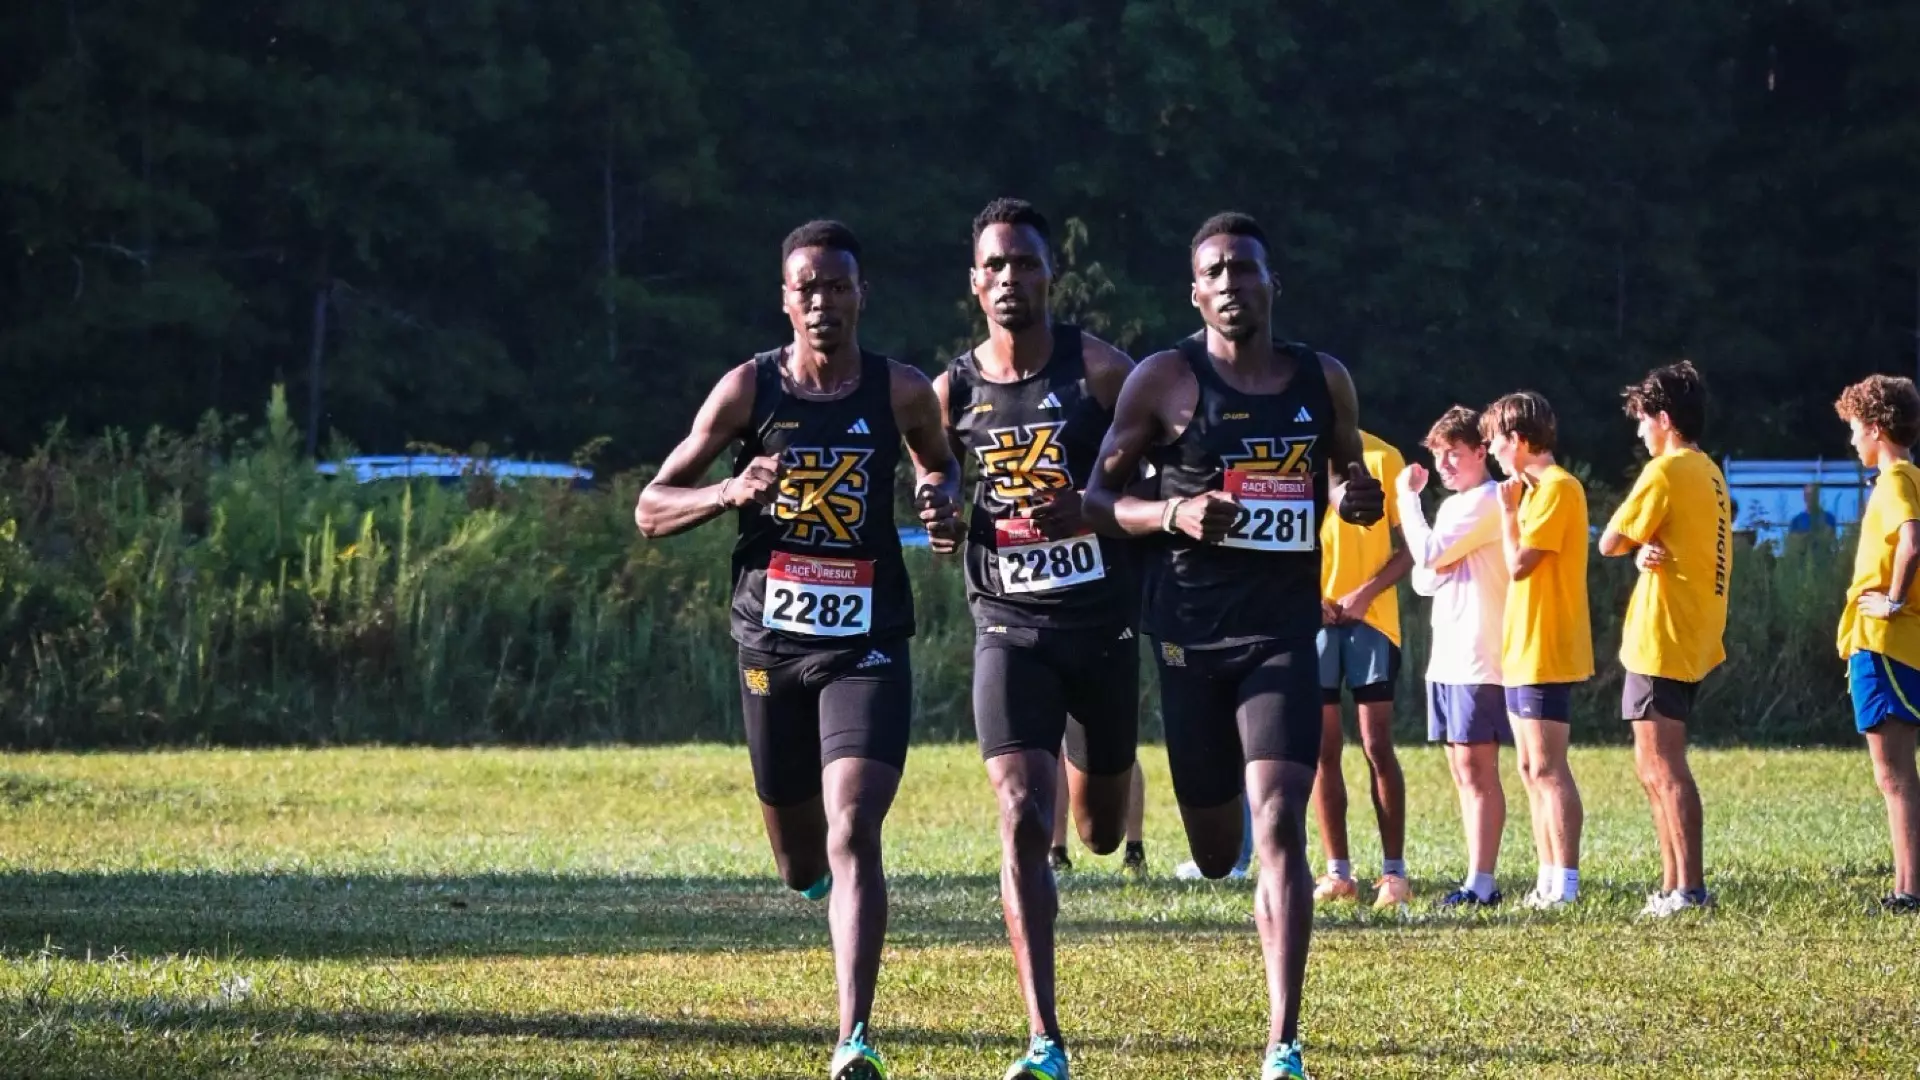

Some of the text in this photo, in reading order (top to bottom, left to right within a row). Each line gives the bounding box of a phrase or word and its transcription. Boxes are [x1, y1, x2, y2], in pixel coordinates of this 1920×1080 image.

[1241, 482, 1306, 493] RACE RESULT
[1227, 507, 1308, 543] 2281
[1711, 477, 1727, 595] FLY HIGHER
[784, 564, 811, 577] RACE
[823, 568, 858, 580] RESULT
[1007, 541, 1095, 585] 2280
[772, 588, 864, 628] 2282
